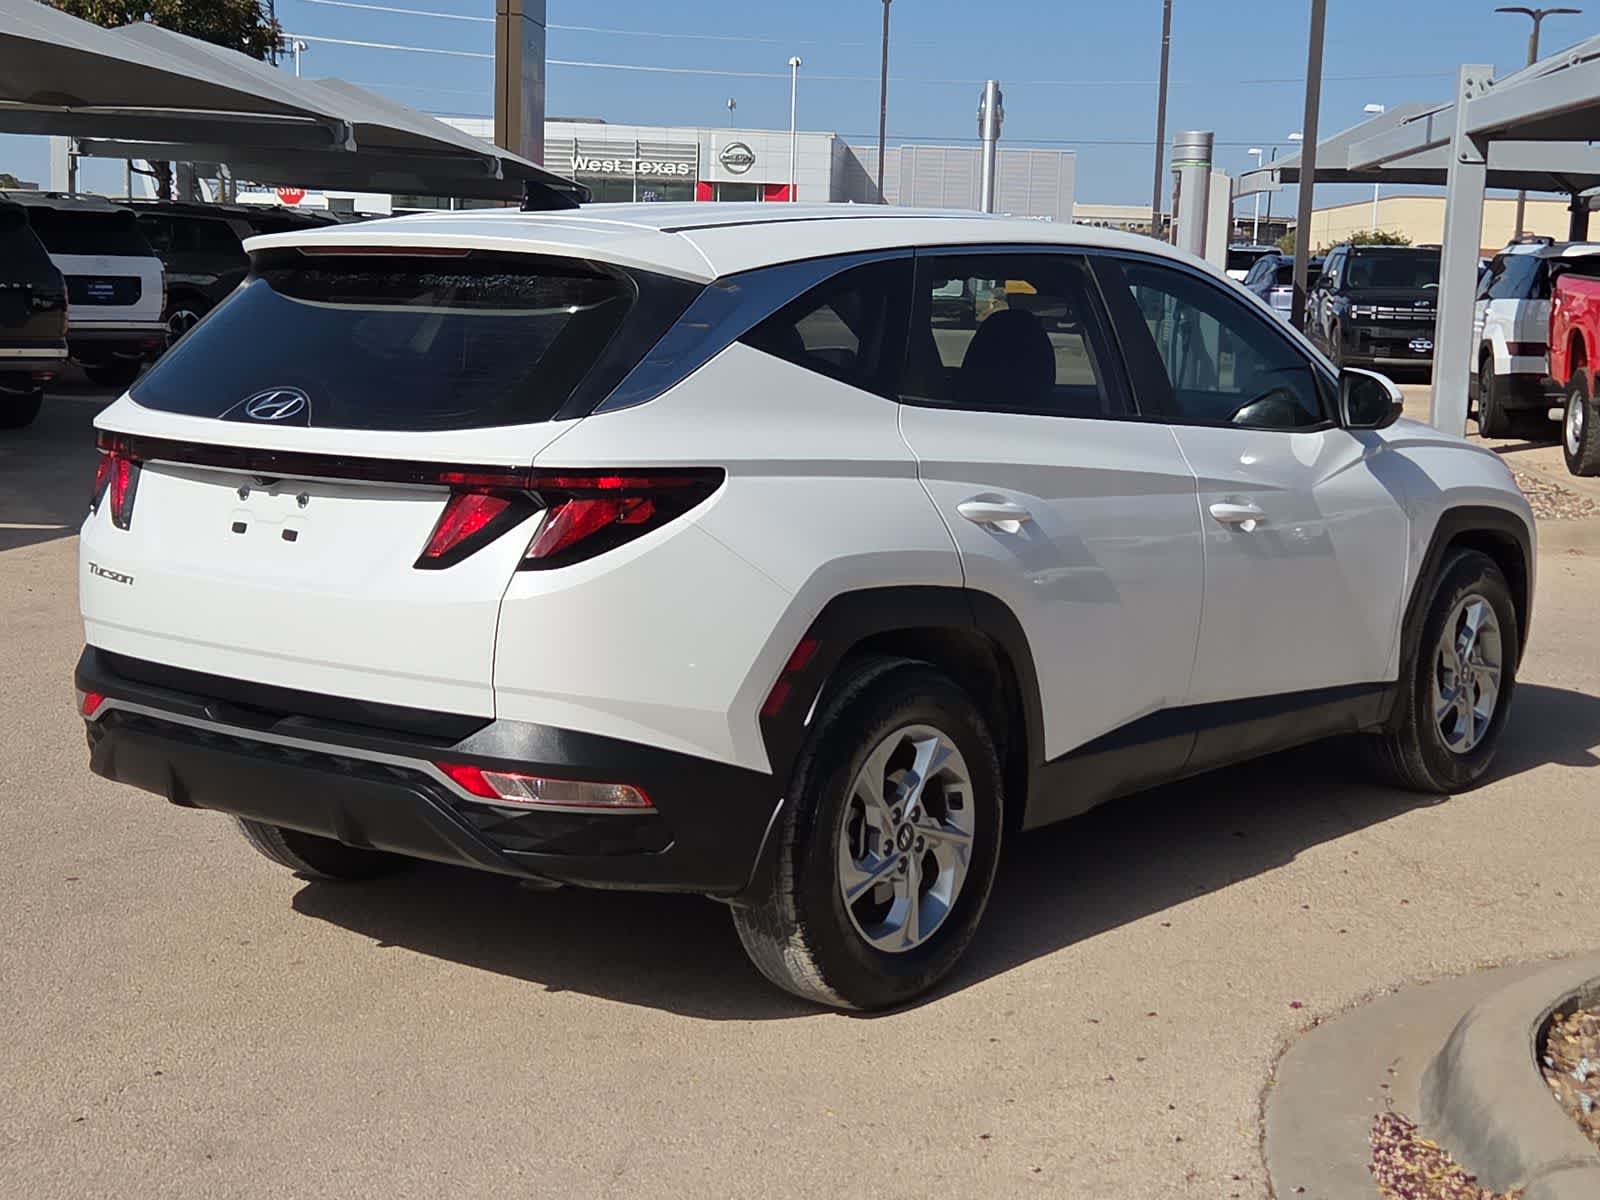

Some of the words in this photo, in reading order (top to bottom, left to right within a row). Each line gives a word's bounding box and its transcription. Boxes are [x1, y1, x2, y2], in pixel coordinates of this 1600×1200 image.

[570, 156, 621, 172] West
[628, 159, 689, 174] Texas
[88, 561, 134, 585] Tucson
